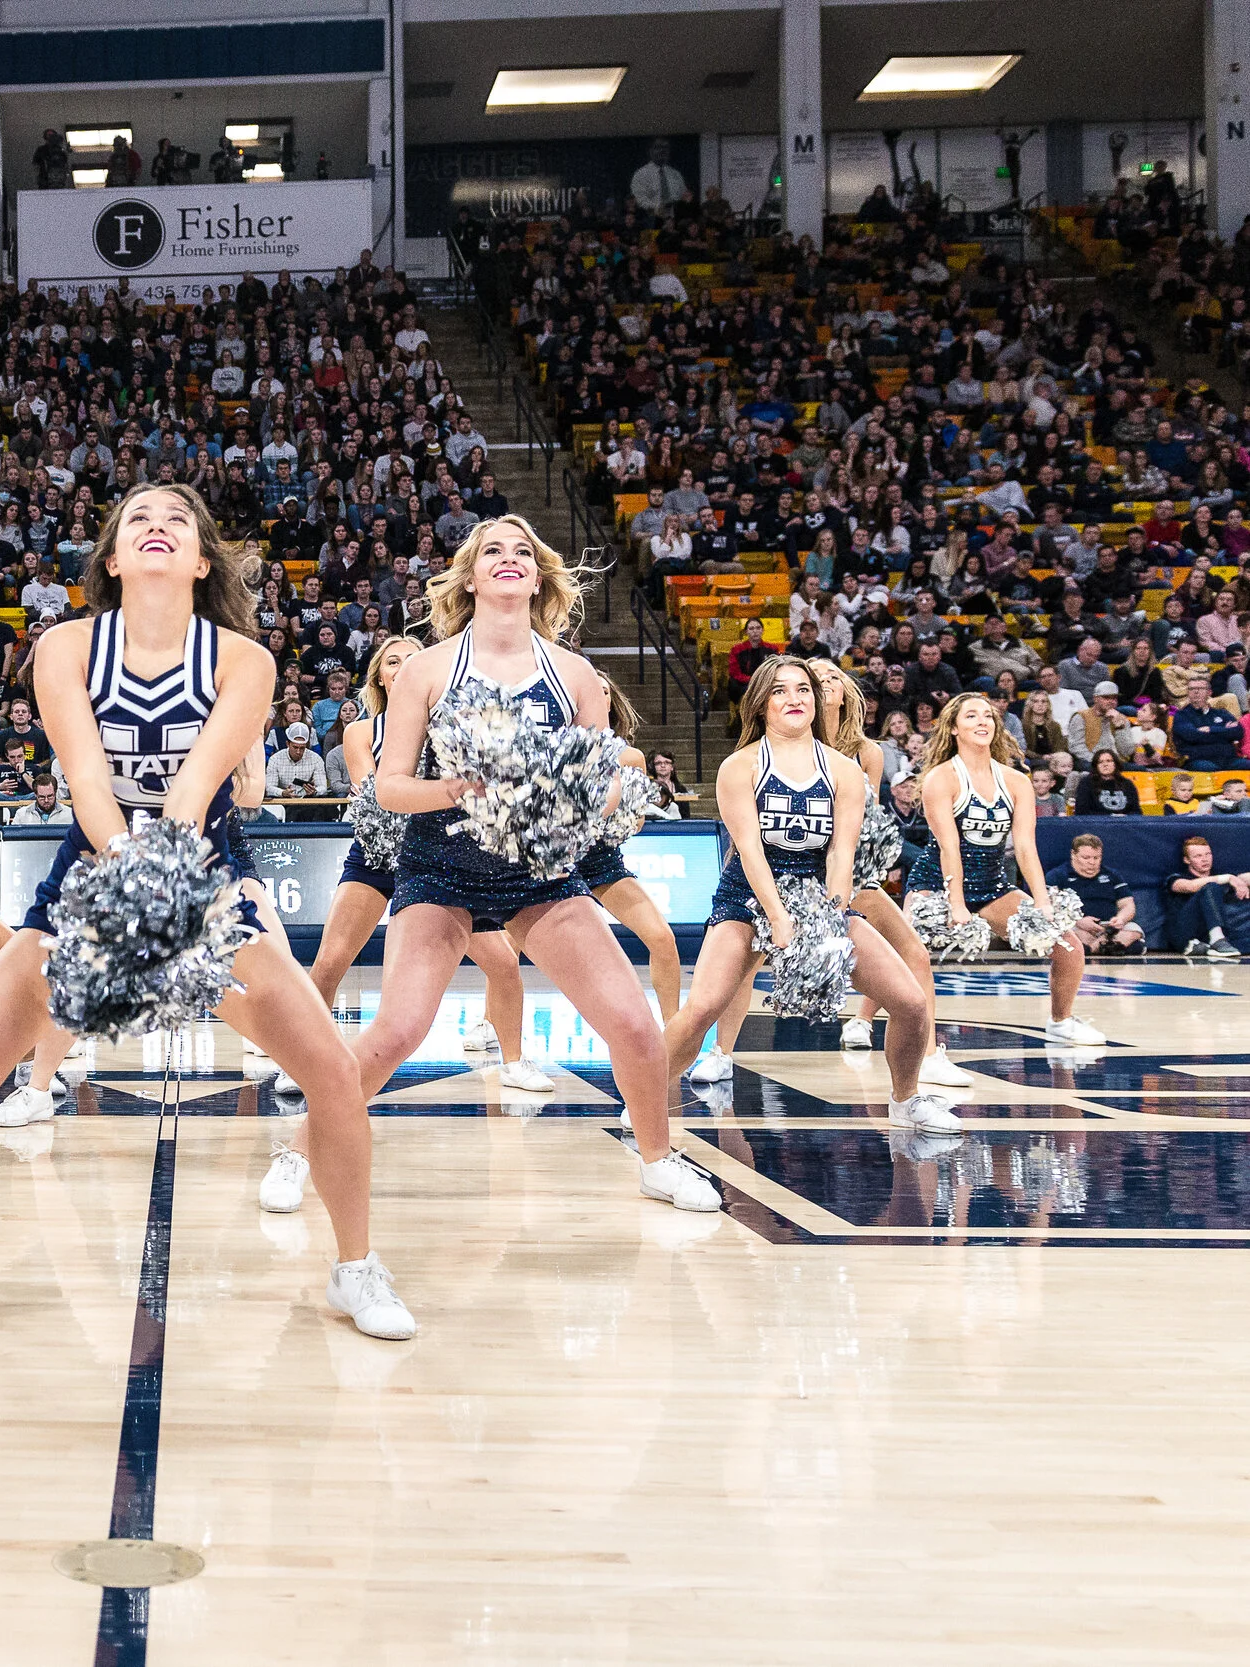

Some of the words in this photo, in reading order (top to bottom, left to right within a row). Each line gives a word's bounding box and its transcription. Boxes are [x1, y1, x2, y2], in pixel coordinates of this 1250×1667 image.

[1227, 121, 1244, 139] N
[794, 134, 814, 153] M
[176, 203, 294, 241] Fisher
[114, 214, 145, 255] F
[171, 243, 215, 258] Home
[218, 241, 300, 259] Furnishings
[759, 811, 833, 835] STATE
[961, 817, 1011, 832] STATE
